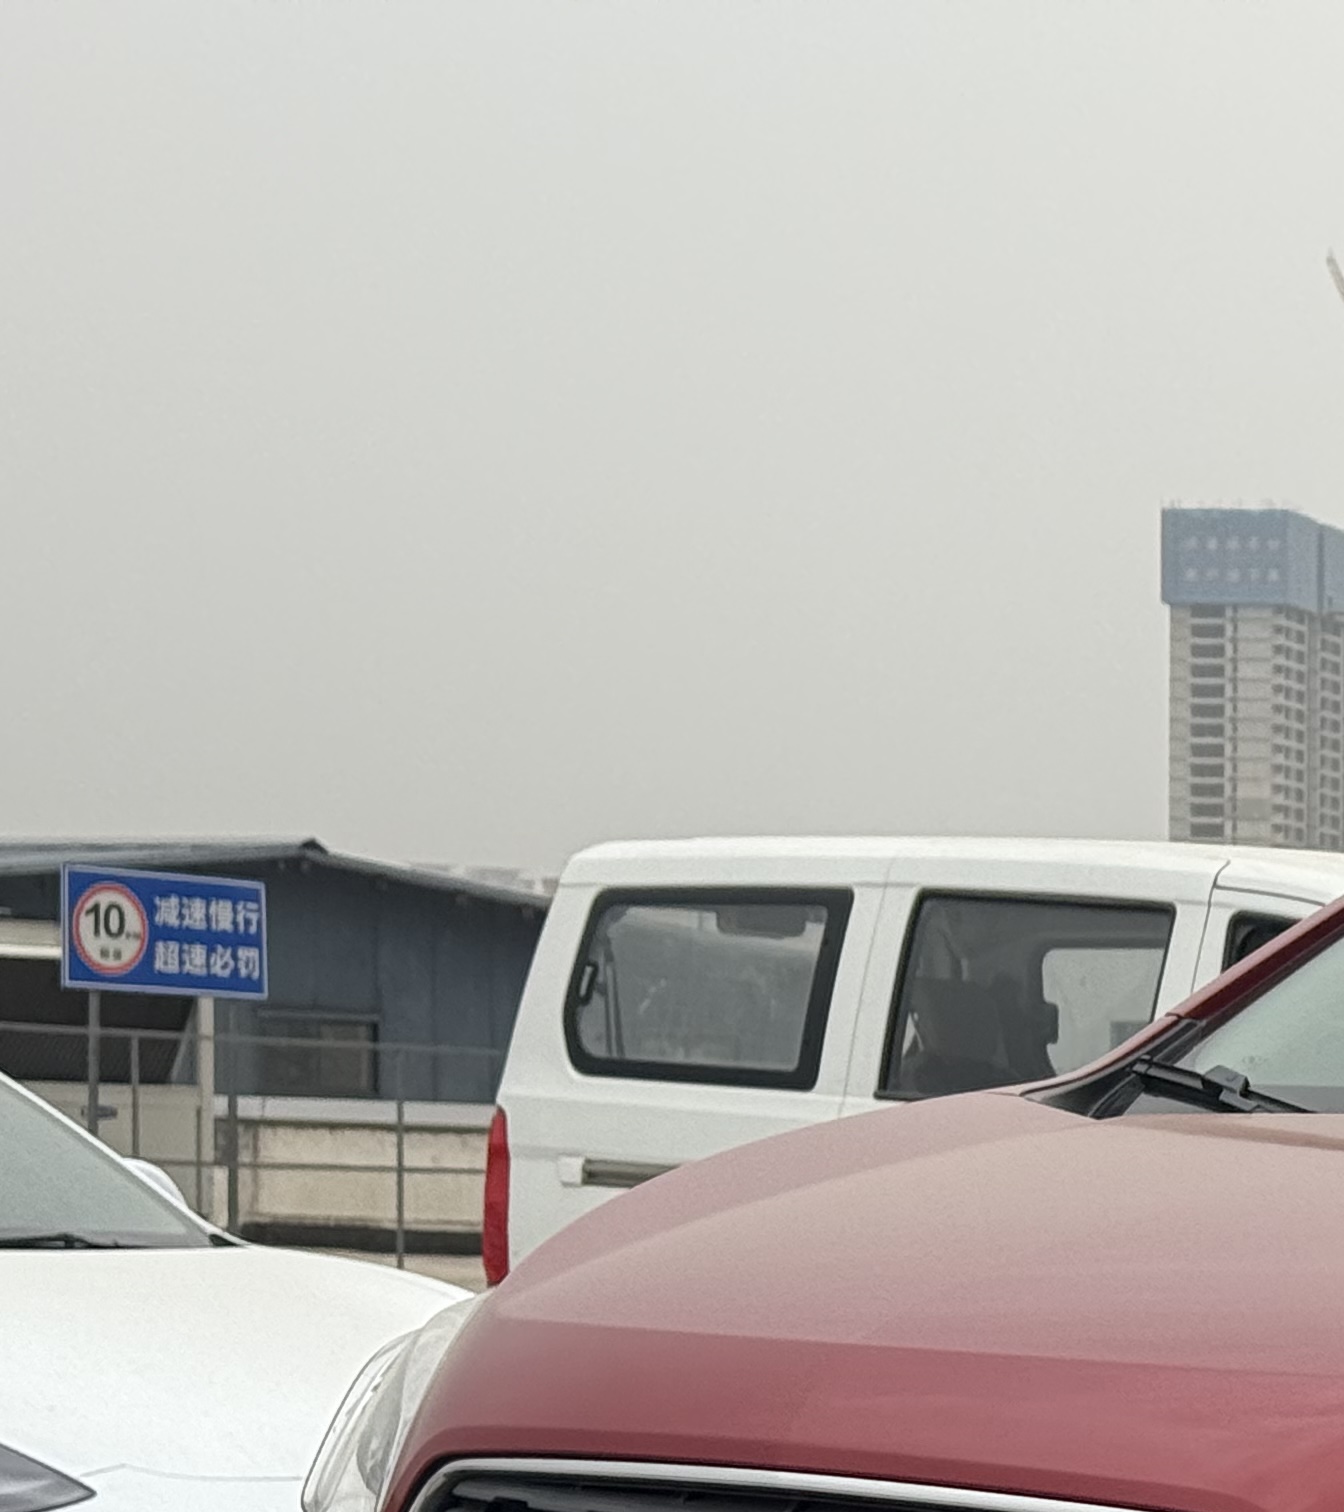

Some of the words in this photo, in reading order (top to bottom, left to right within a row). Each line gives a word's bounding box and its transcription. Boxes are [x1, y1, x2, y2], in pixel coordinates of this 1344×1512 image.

[85, 902, 125, 938] 10
[155, 894, 260, 934] 减速慢行
[155, 940, 260, 980] 超速必罚
